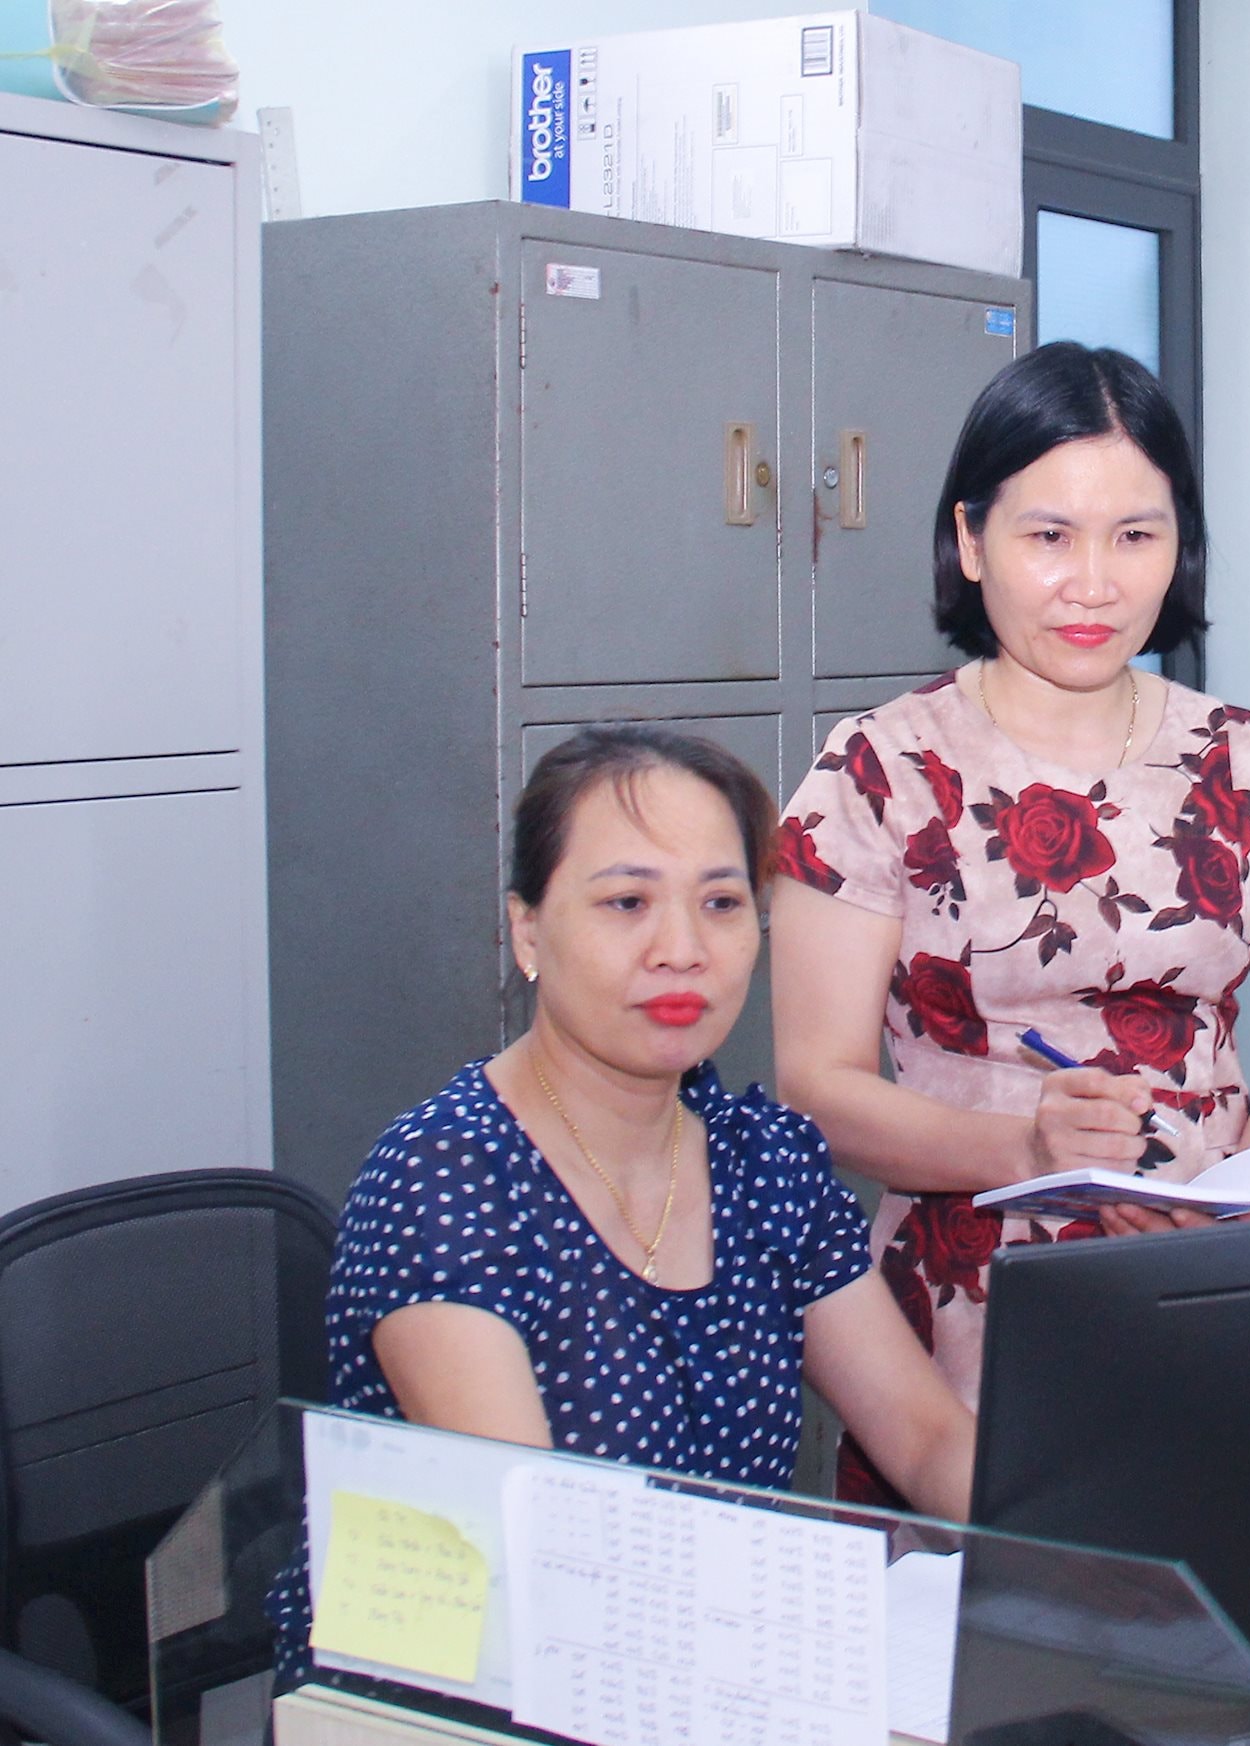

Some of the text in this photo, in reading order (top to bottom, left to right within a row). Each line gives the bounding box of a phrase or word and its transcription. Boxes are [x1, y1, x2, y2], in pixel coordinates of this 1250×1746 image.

[528, 62, 554, 182] brother
[552, 80, 568, 159] at your side
